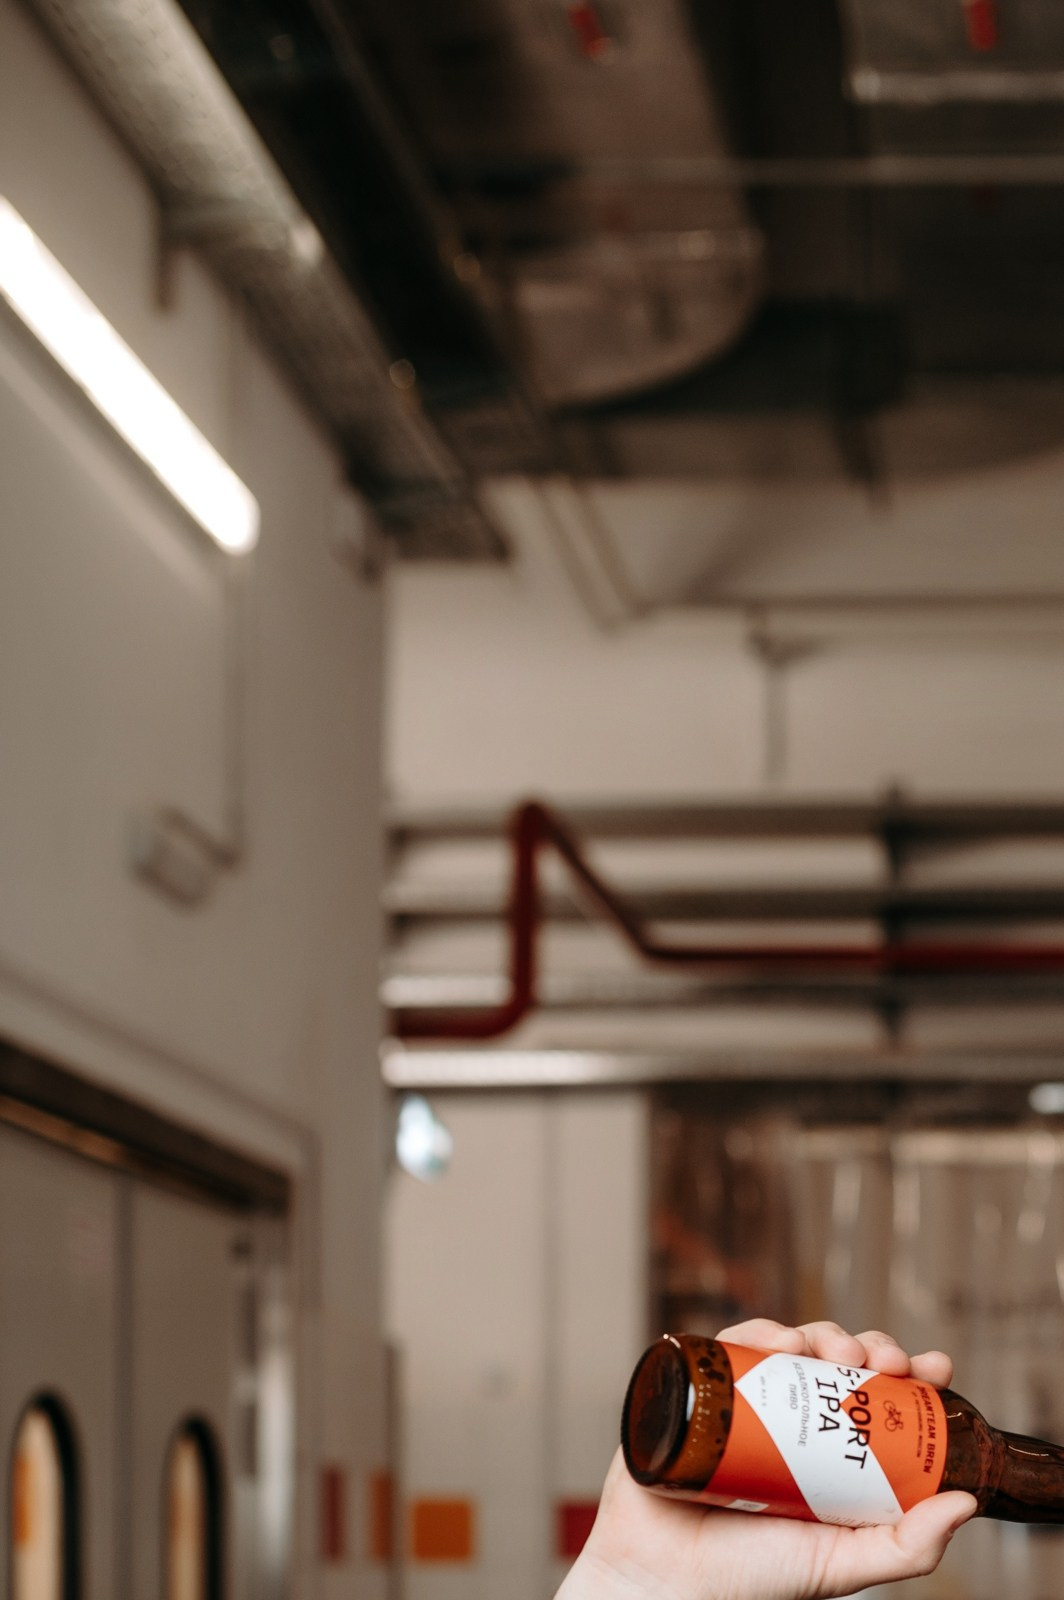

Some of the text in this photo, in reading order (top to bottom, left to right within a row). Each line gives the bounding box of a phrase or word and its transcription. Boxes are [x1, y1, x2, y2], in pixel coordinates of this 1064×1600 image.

[788, 1383, 799, 1411] ПИВО
[815, 1377, 842, 1432] IPA
[837, 1366, 873, 1470] S-PORT
[923, 1443, 936, 1474] BREW
